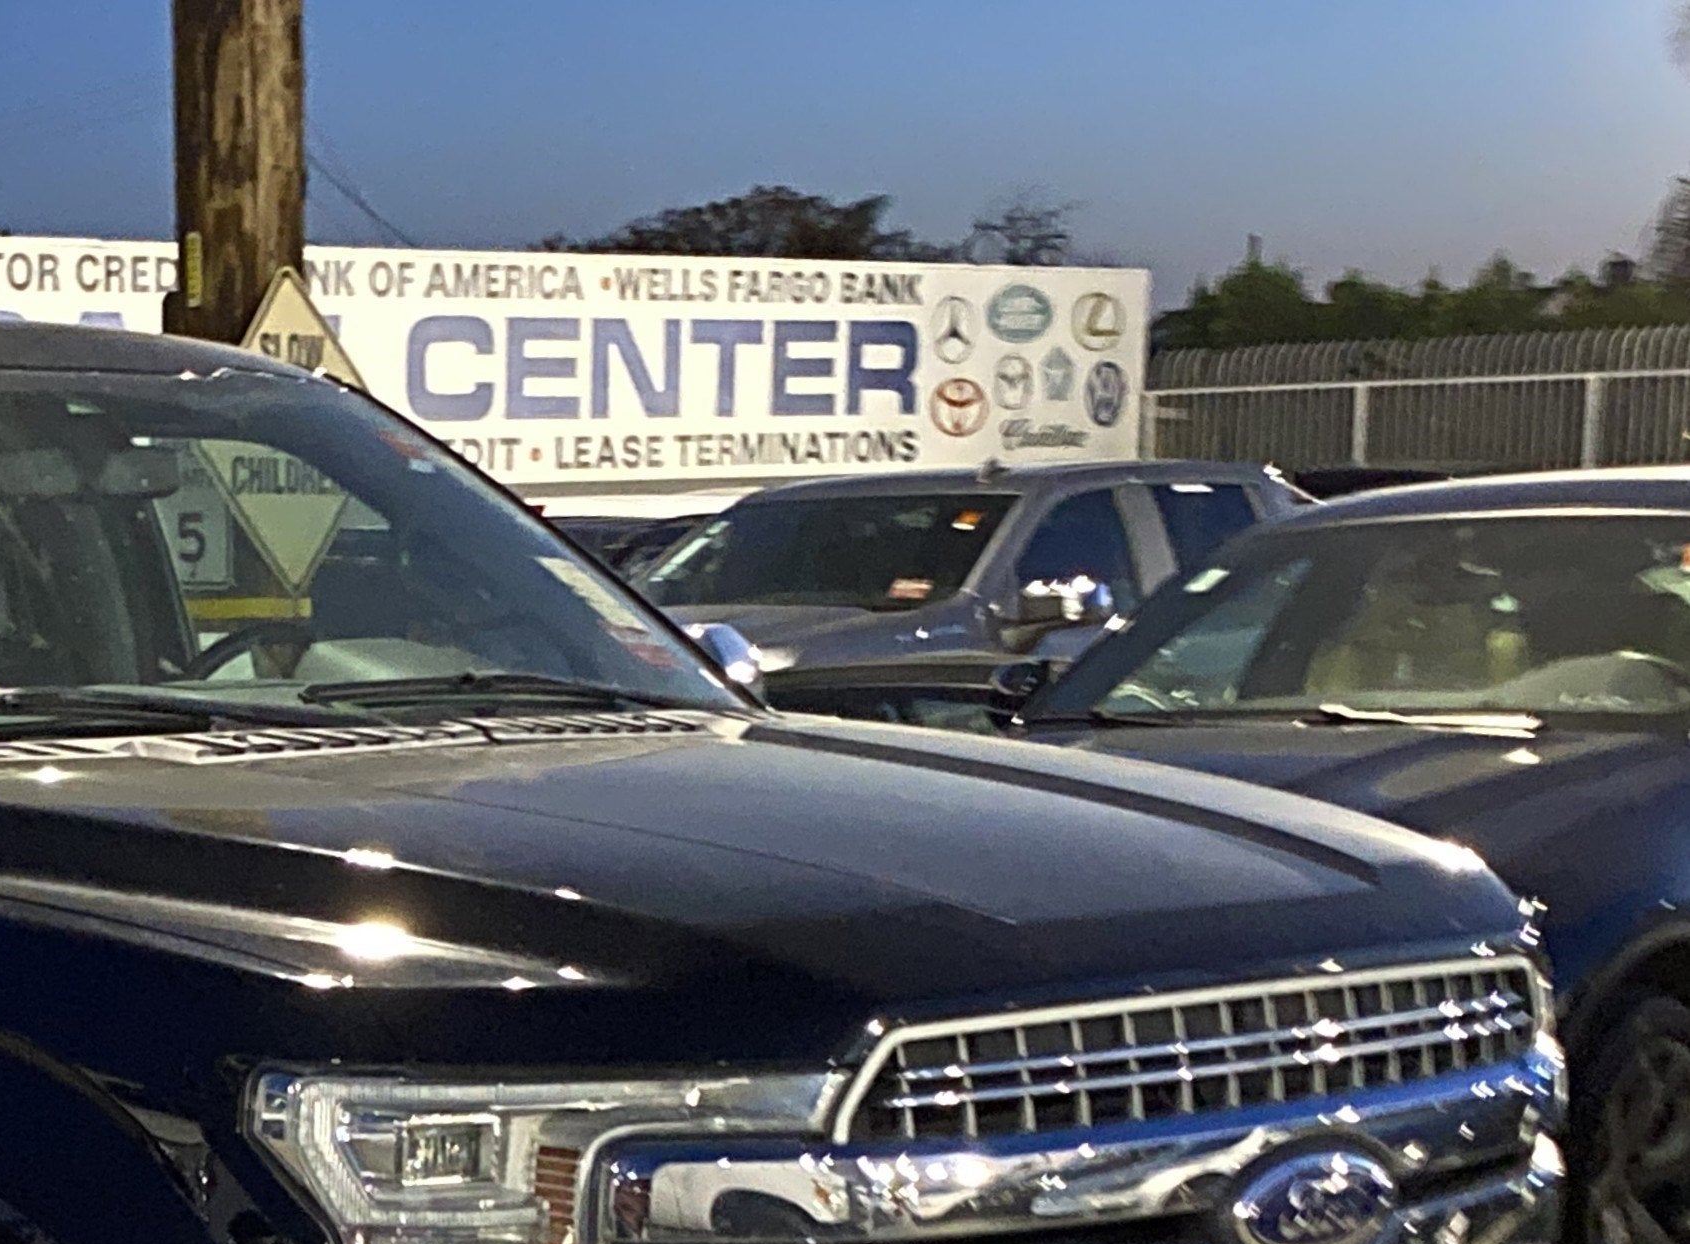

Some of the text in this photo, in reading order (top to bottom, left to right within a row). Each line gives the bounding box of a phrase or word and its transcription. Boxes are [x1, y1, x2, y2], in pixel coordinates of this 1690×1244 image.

[306, 260, 356, 297] NK
[368, 262, 415, 297] OF
[423, 262, 585, 300] AMERICA
[614, 267, 719, 301] WELLS
[728, 269, 831, 304] FARGO
[840, 272, 924, 305] BANK
[406, 315, 919, 422] CENTER
[554, 435, 664, 469] LEASE
[674, 431, 920, 467] TERMINATIONS
[177, 512, 206, 563] 5
